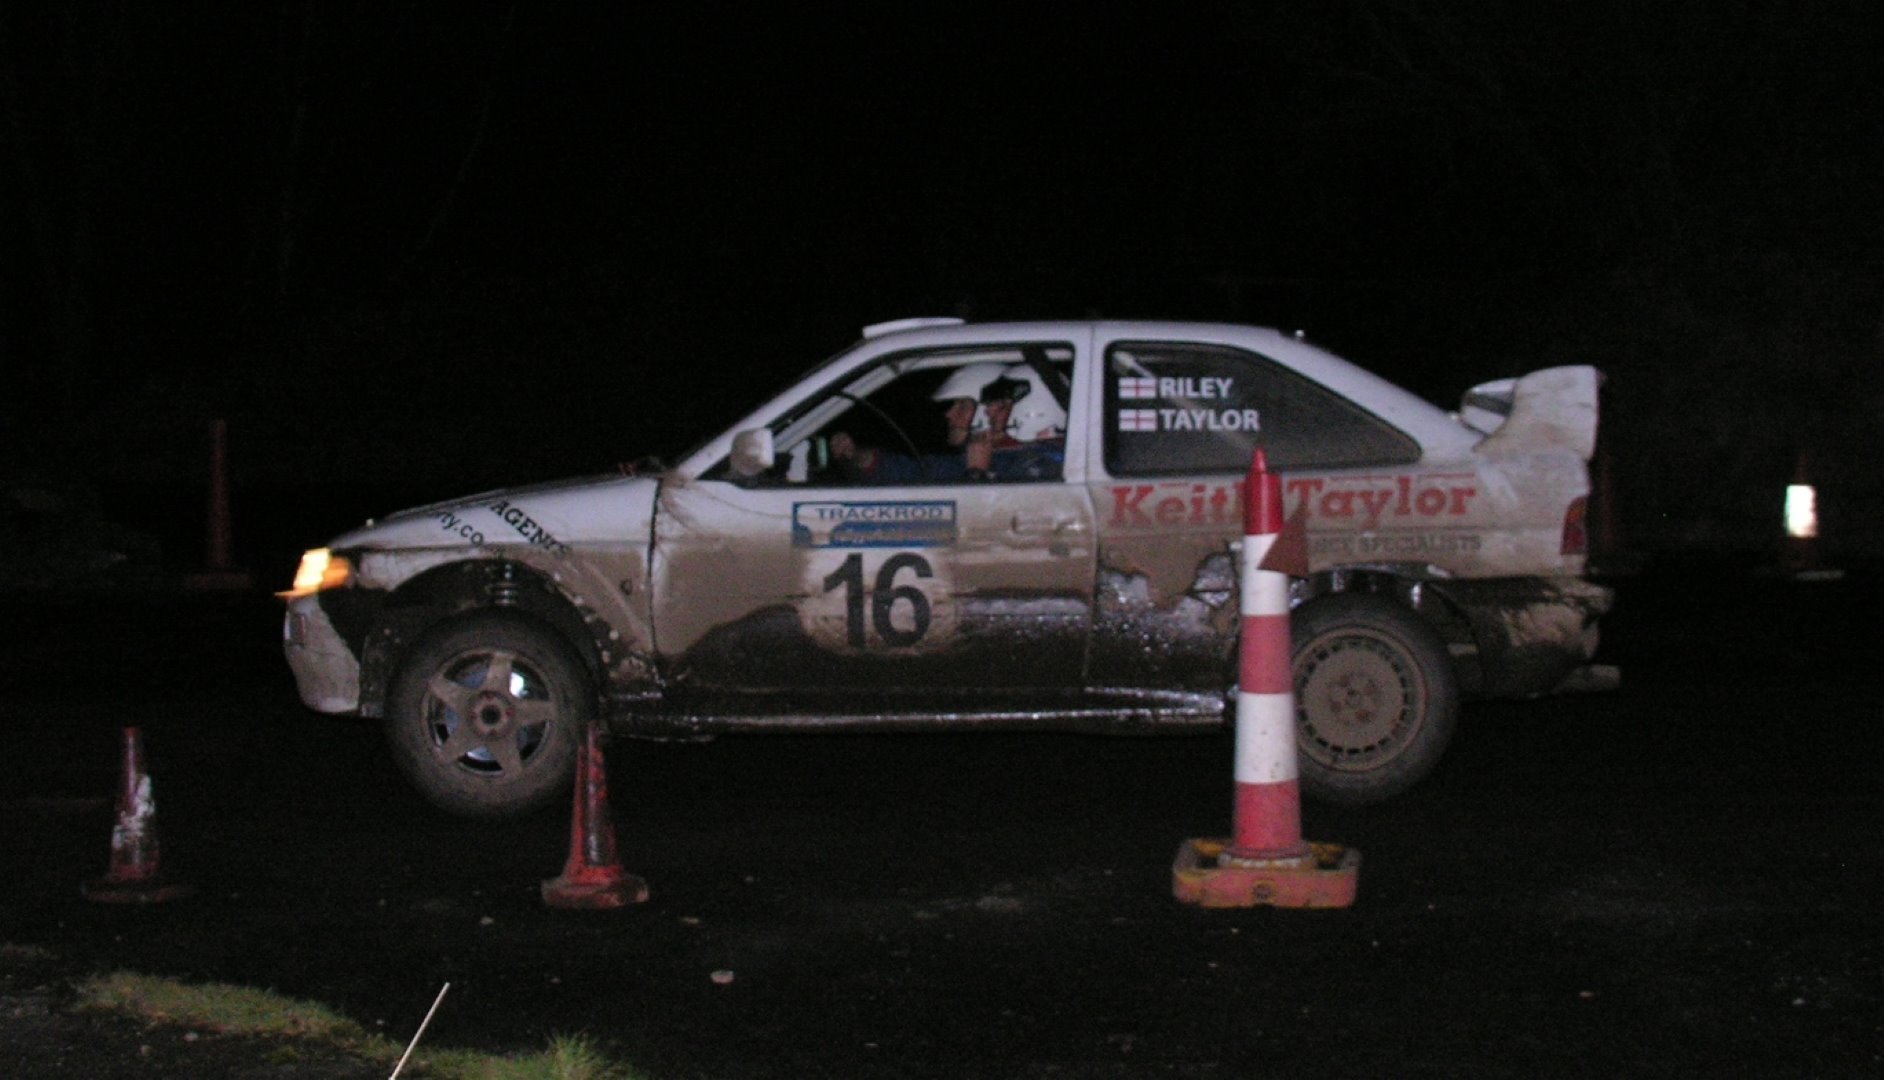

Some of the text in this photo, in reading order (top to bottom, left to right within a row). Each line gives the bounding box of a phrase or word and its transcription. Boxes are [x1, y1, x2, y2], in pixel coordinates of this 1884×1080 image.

[1159, 377, 1234, 398] RILEY
[1159, 409, 1260, 431] TAYLOR
[814, 506, 943, 520] TRACKROD
[1287, 476, 1476, 529] Taylor
[823, 553, 933, 649] 16
